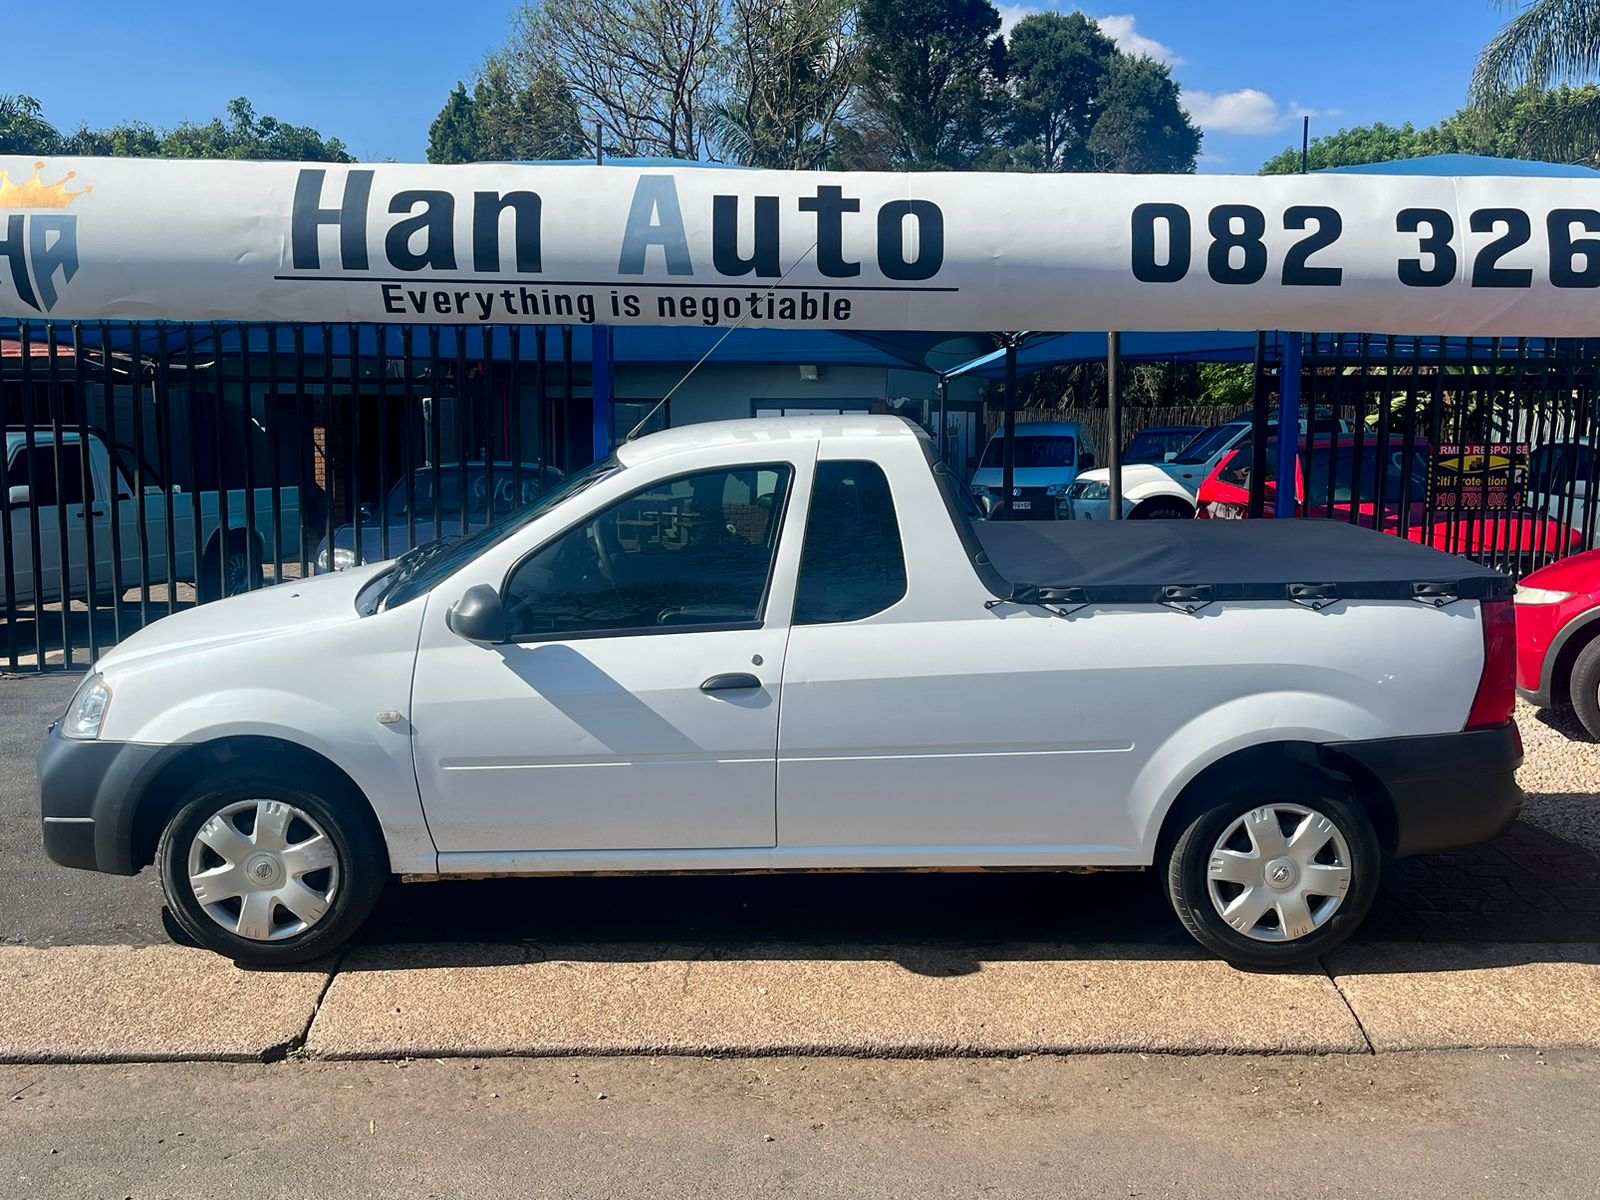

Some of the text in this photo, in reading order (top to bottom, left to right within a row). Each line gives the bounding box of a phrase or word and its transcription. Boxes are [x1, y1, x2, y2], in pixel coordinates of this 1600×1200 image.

[292, 169, 945, 281] Han Auto
[1131, 202, 1600, 289] 082 326
[381, 284, 852, 326] Everything is negotiable
